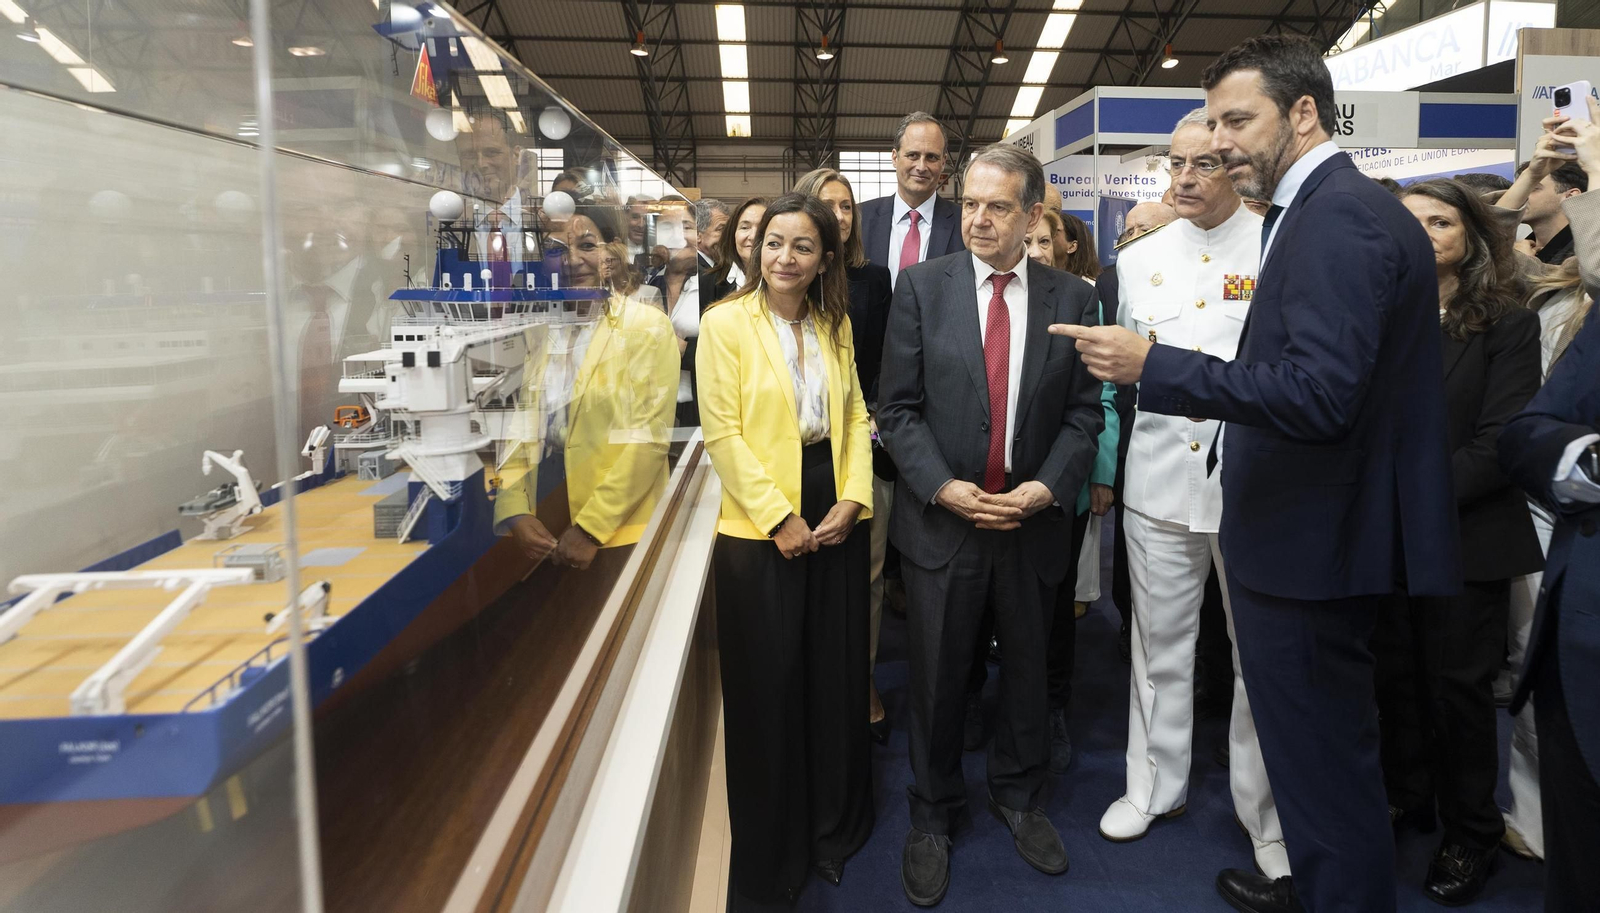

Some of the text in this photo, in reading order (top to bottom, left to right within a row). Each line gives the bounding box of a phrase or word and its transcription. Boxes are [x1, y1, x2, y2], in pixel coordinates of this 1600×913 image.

[1429, 61, 1461, 81] Mar
[1394, 156, 1404, 166] DE
[1407, 154, 1418, 164] LA
[1104, 174, 1157, 185] Veritas
